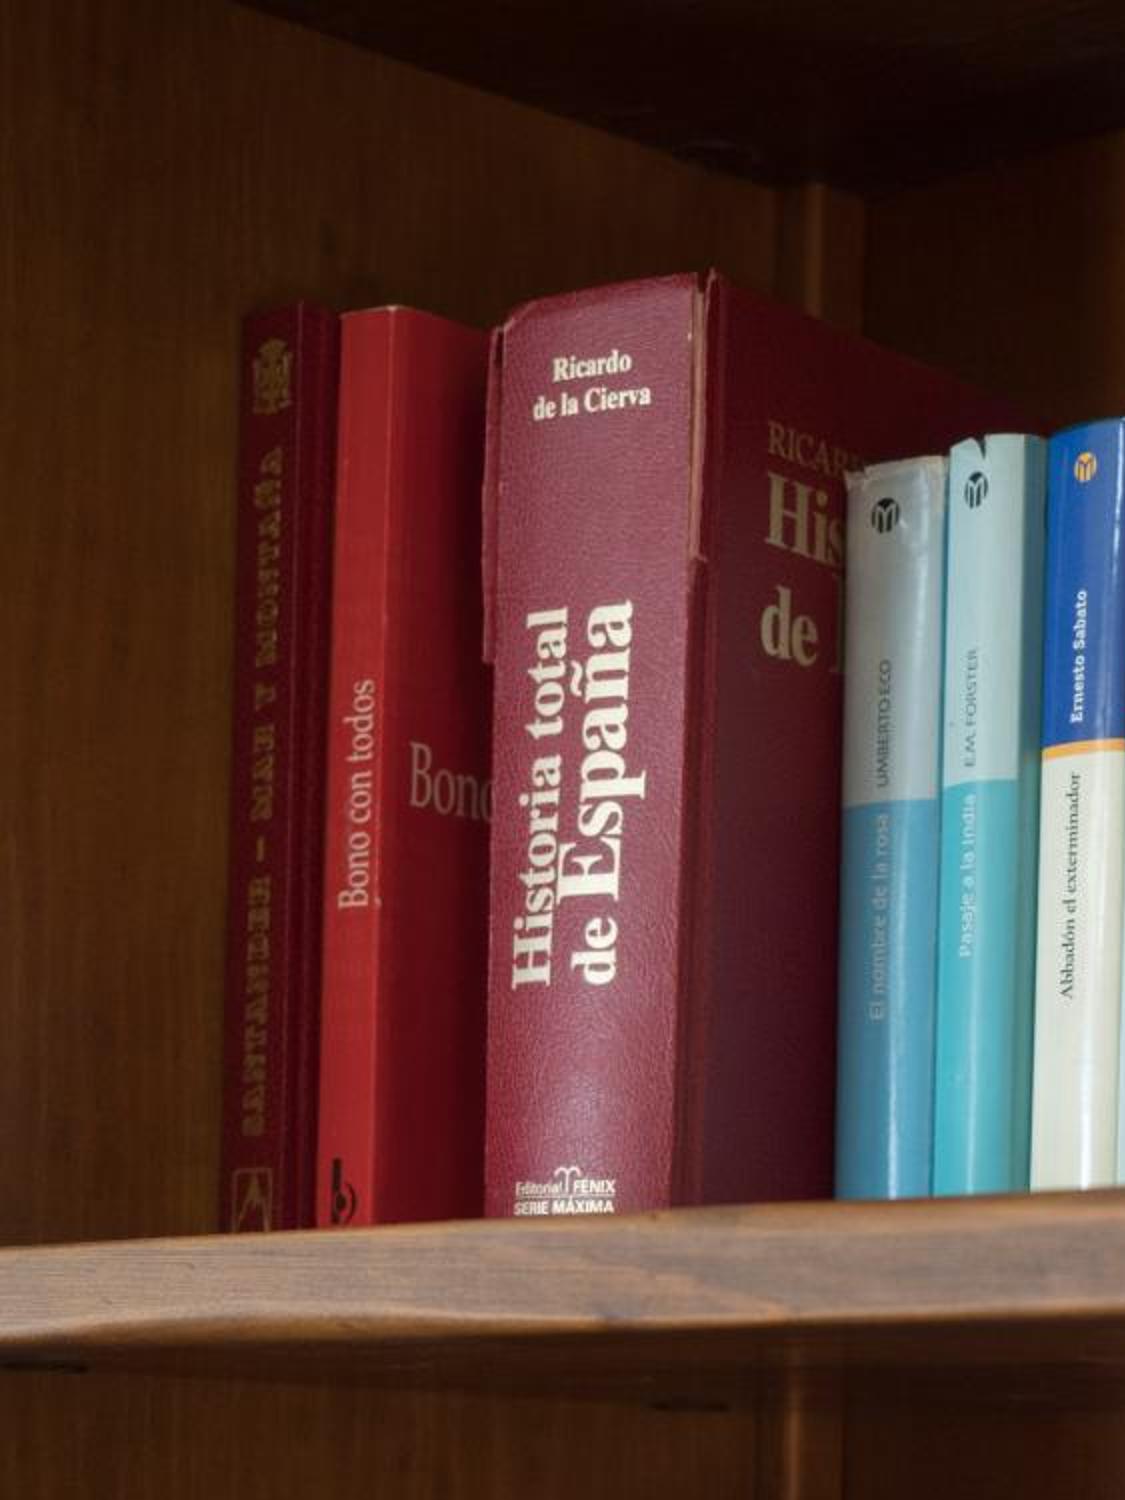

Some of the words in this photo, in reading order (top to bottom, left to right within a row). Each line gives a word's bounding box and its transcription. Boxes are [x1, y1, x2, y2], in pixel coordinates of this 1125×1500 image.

[553, 349, 632, 382] Ricardo
[533, 396, 557, 421] de
[561, 392, 579, 416] la
[584, 387, 651, 413] Cierva
[768, 420, 856, 477] RICAR
[760, 584, 819, 667] de
[1071, 590, 1087, 650] Sabato
[525, 606, 569, 740] total
[878, 658, 892, 695] ECO
[965, 649, 978, 725] FORSTER
[1069, 655, 1085, 723] Ernesto
[343, 679, 375, 762] todos
[556, 599, 646, 905] España
[876, 698, 892, 788] UMBERTO
[350, 770, 373, 824] con
[1064, 771, 1080, 893] exterminador
[338, 831, 371, 909] Bono
[511, 754, 562, 991] Historia
[872, 886, 888, 910] de
[1062, 899, 1077, 913] el
[570, 916, 619, 986] de
[871, 917, 887, 994] nombre
[1060, 919, 1076, 999] Abbadón
[870, 1000, 883, 1021] El
[514, 1201, 549, 1215] SERIE
[551, 1196, 615, 1214] MÁXIMA
[515, 1181, 562, 1196] Editorial
